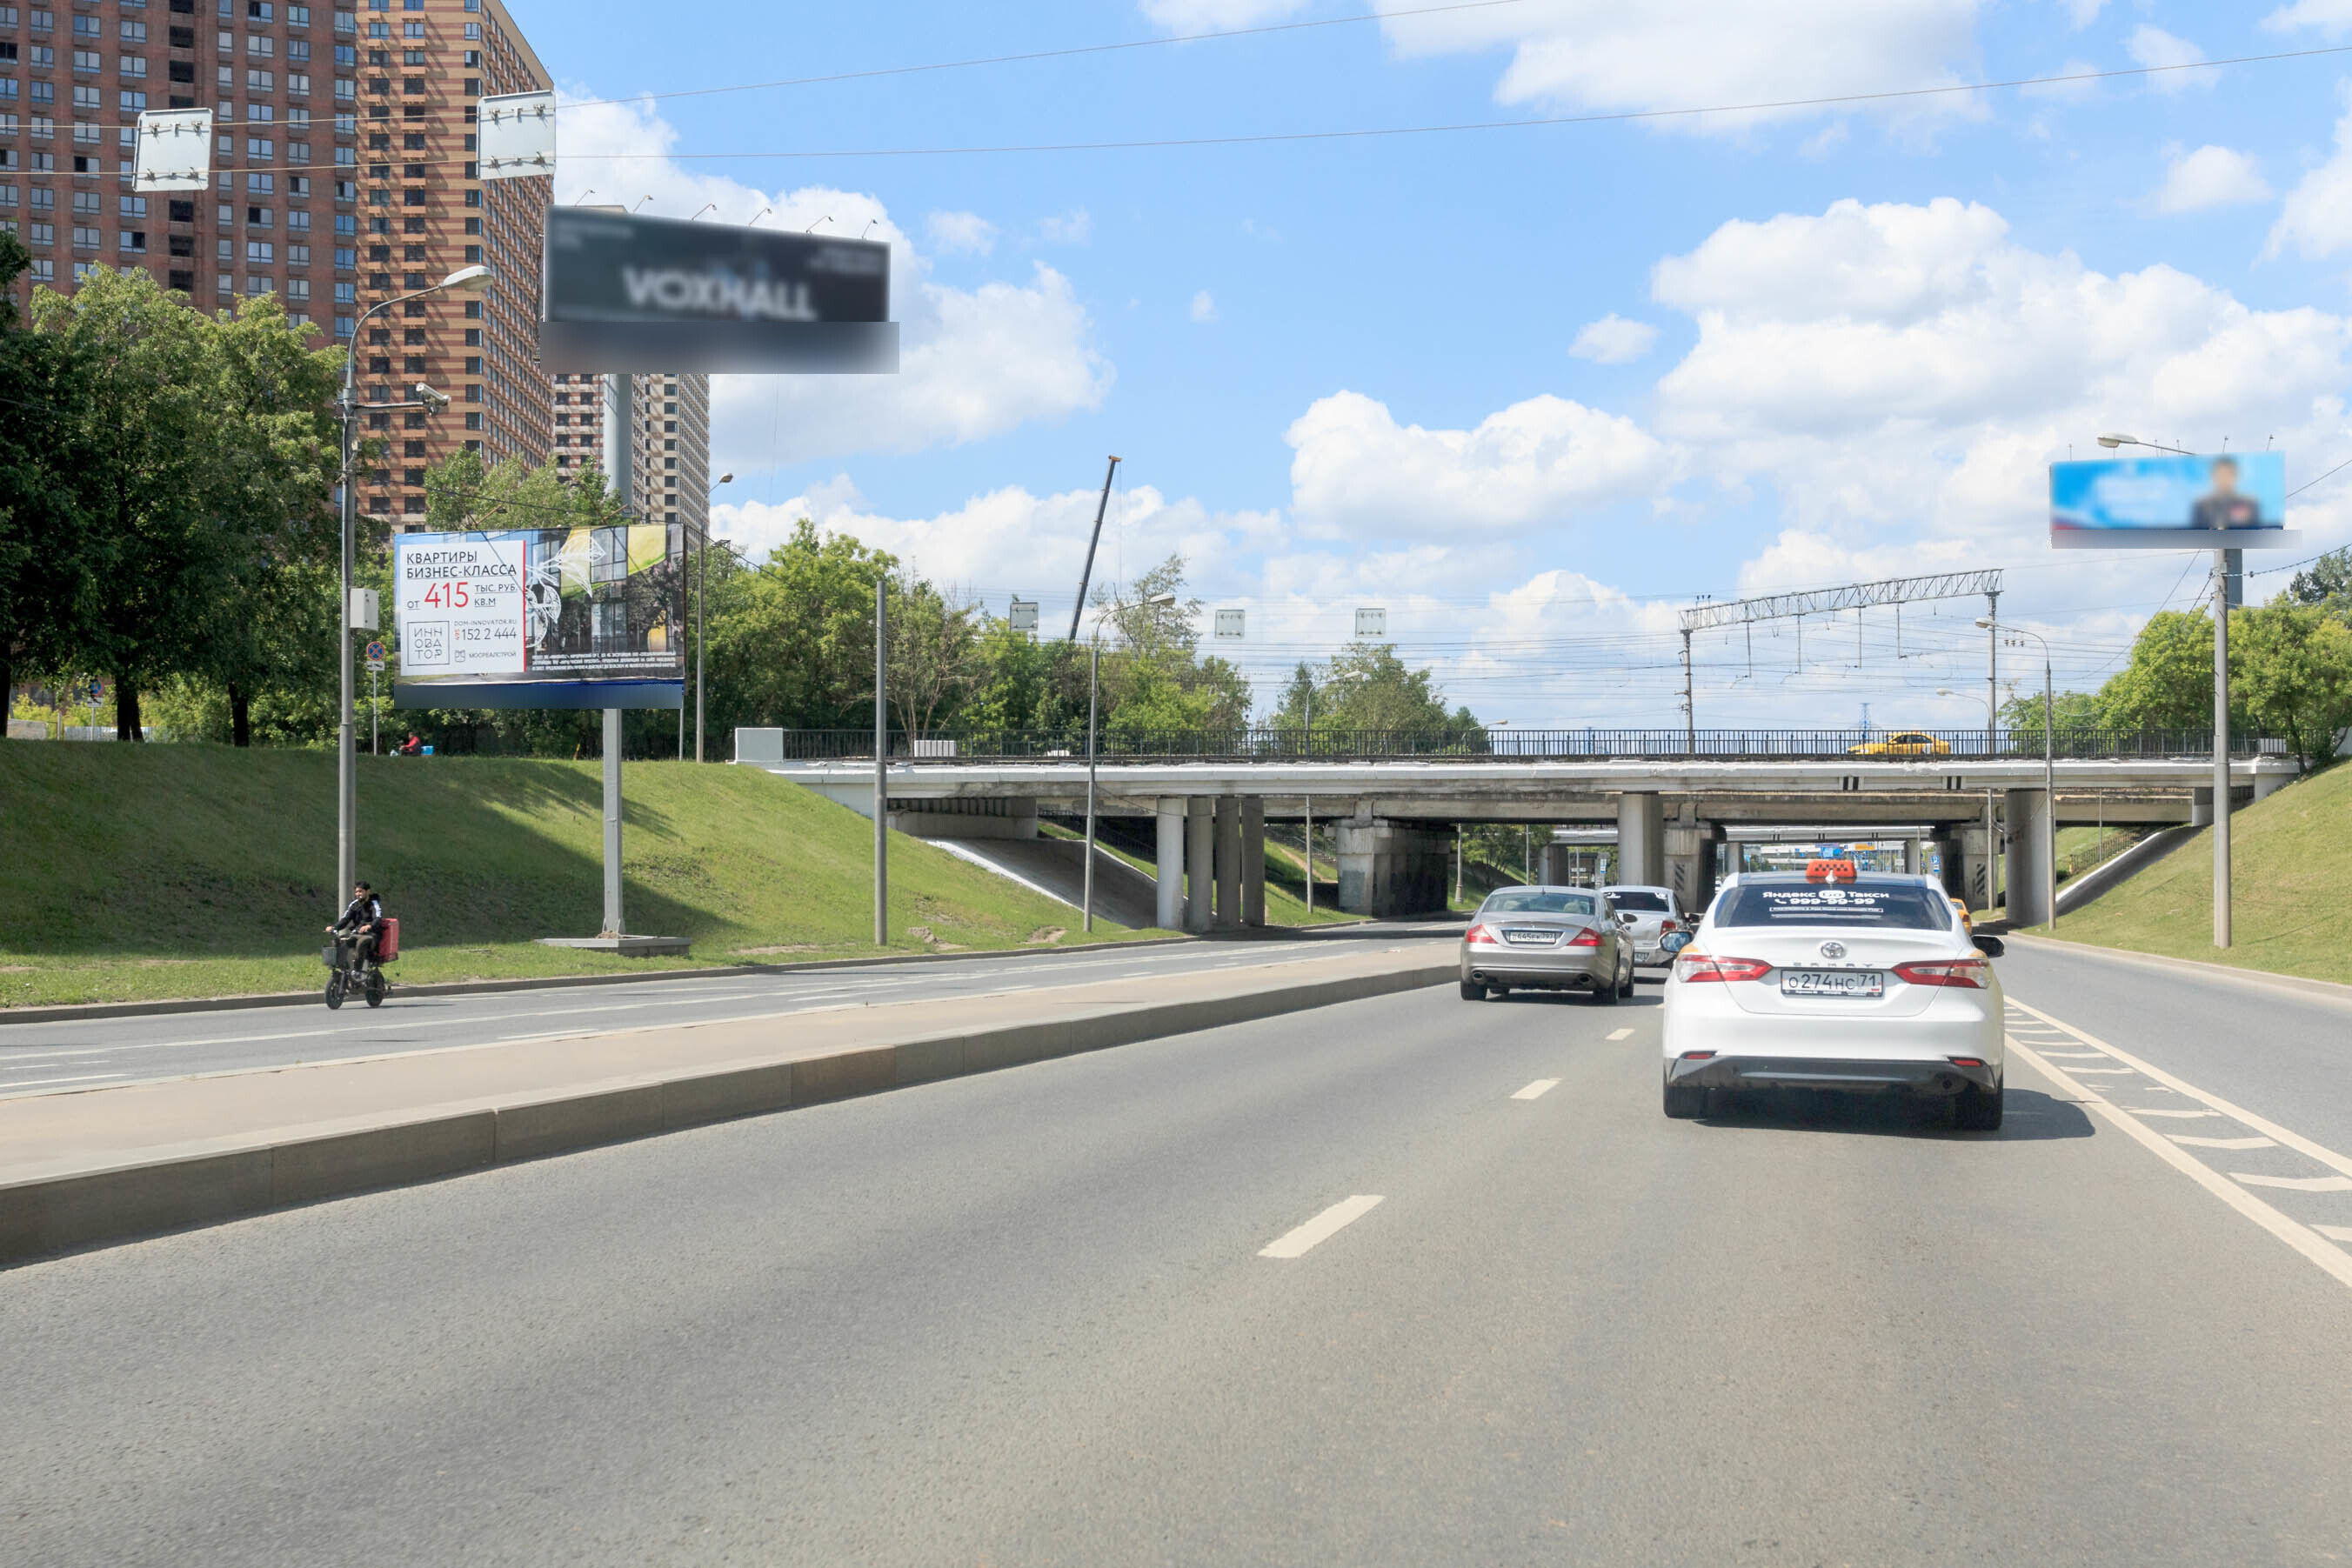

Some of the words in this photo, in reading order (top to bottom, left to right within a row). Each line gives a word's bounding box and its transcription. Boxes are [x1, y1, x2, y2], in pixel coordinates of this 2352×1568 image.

[407, 550, 478, 564] КВАРТИРЫ
[407, 564, 517, 578] БИЗНЕС-КЛАССА
[424, 582, 469, 608] 415
[474, 597, 496, 606] КВ.М
[462, 628, 481, 640] 152
[484, 628, 491, 640] 2
[494, 627, 517, 639] 444
